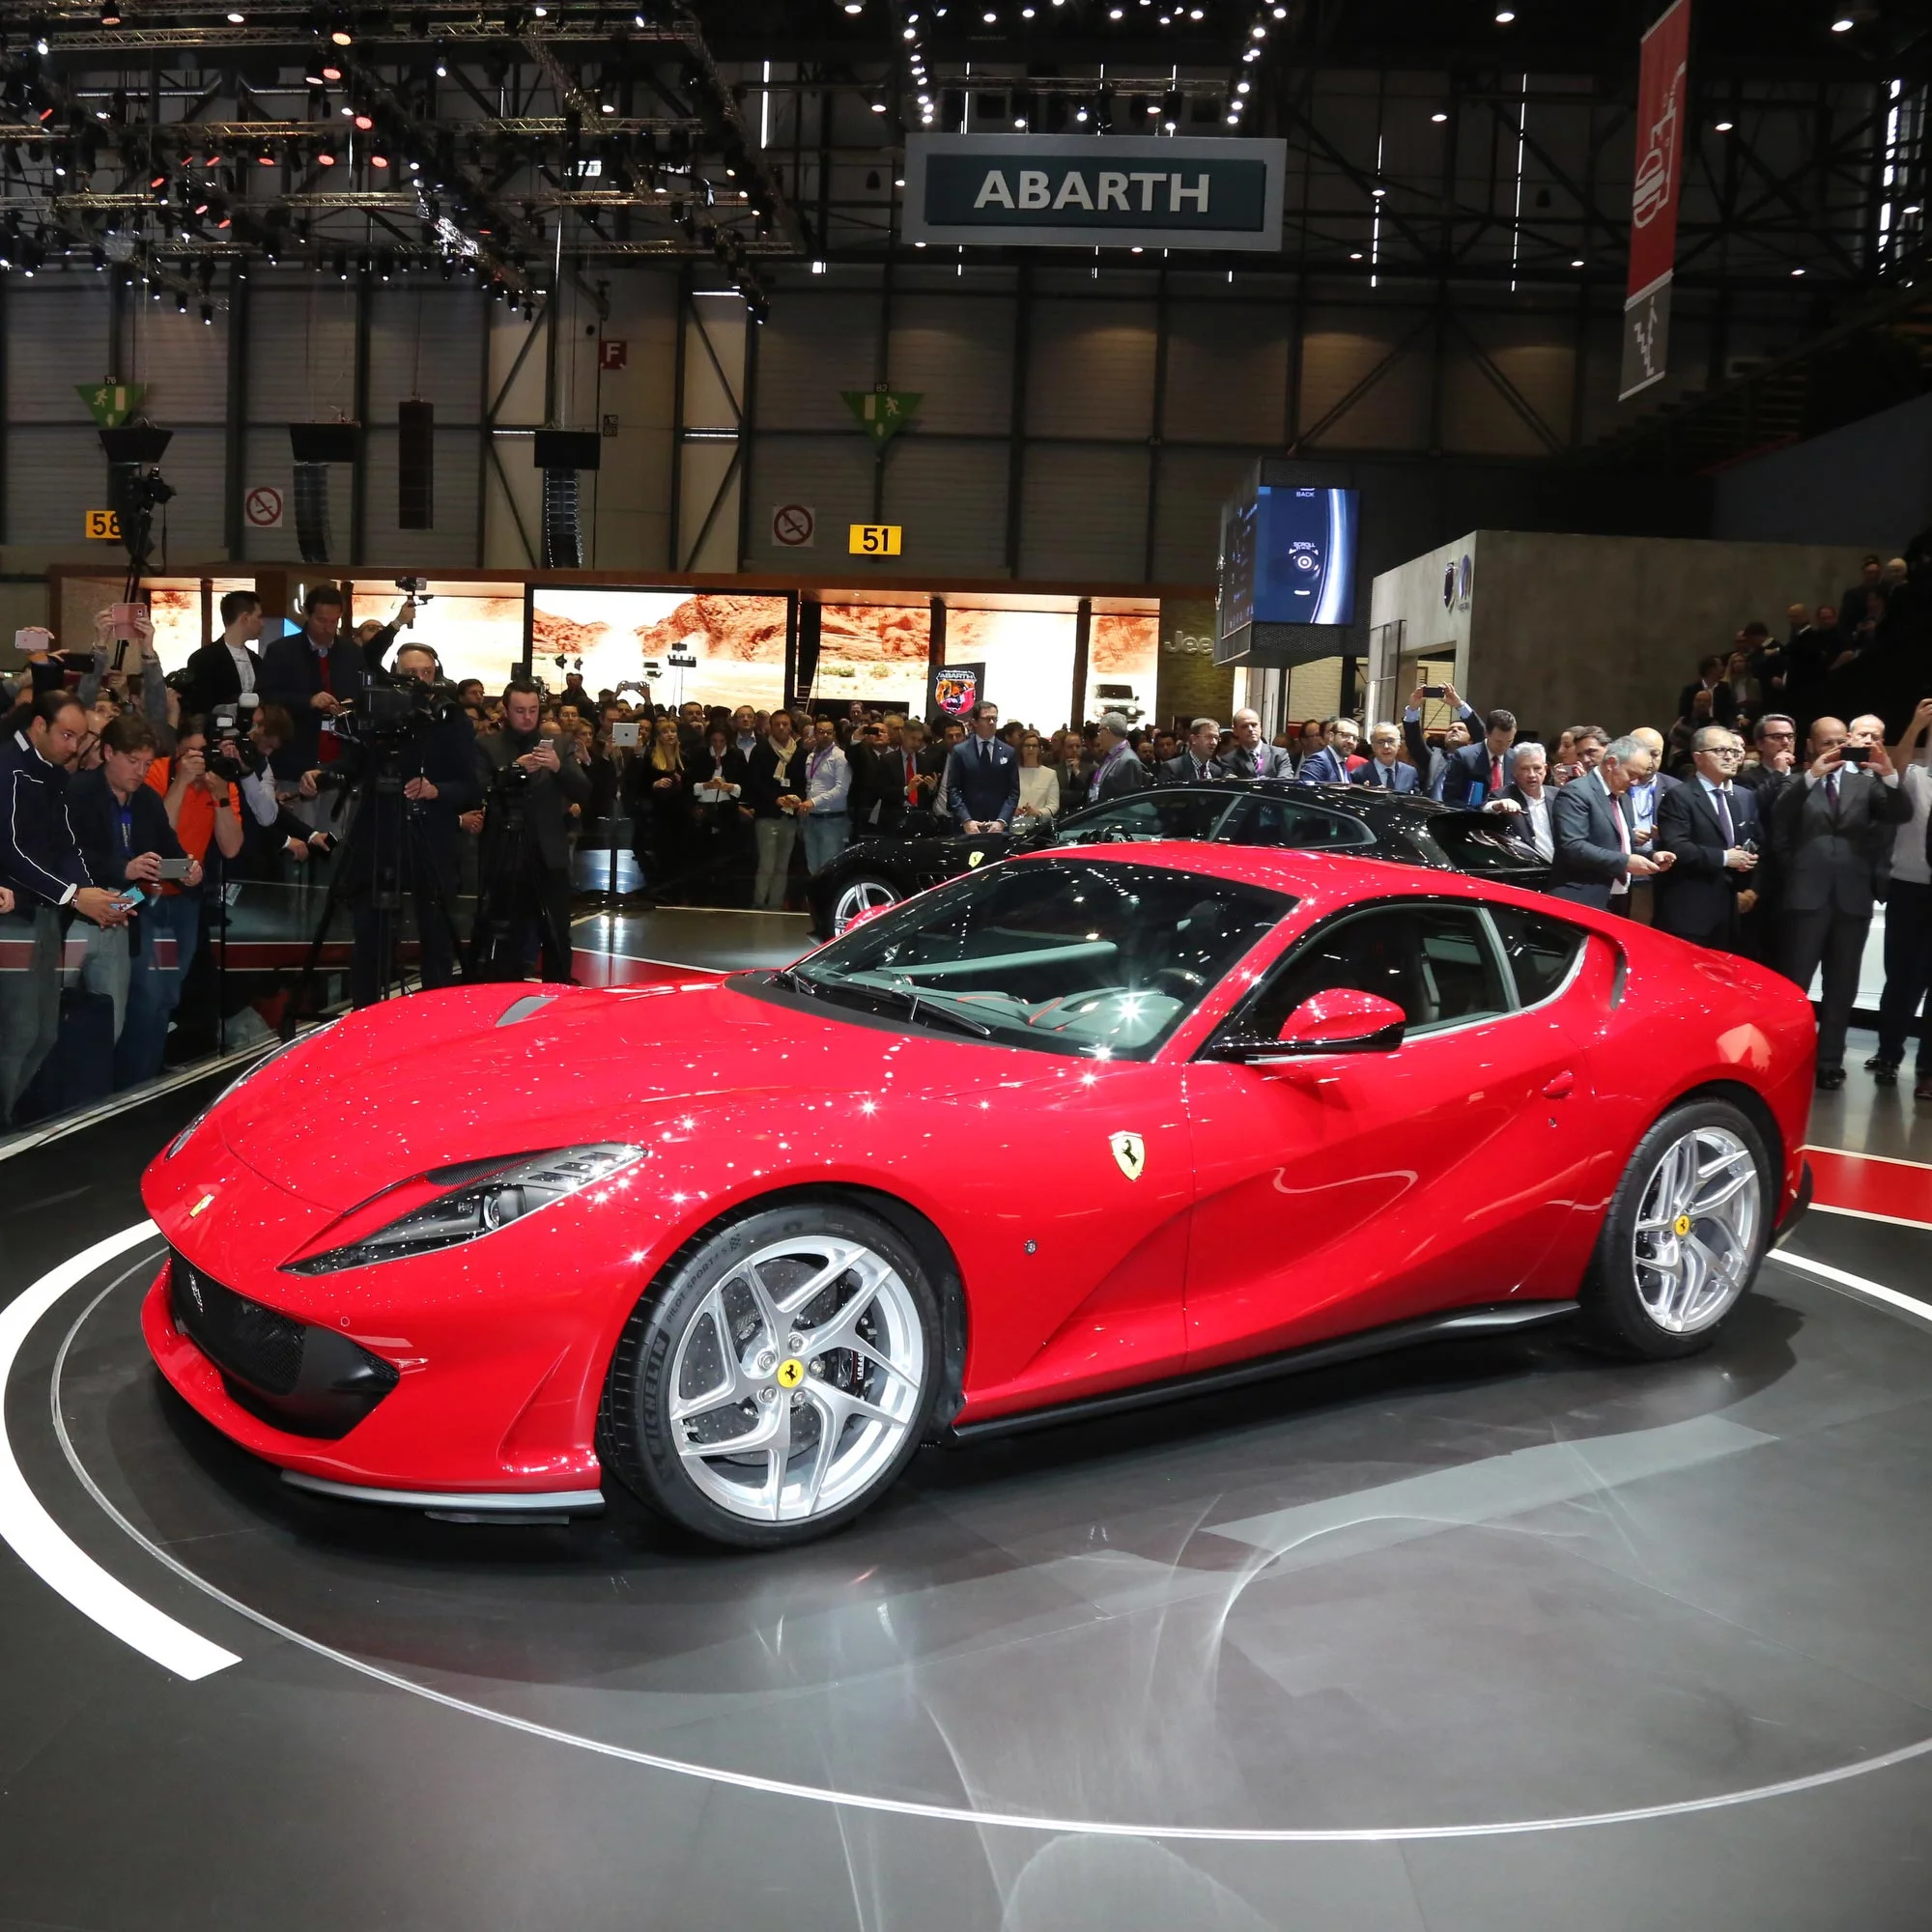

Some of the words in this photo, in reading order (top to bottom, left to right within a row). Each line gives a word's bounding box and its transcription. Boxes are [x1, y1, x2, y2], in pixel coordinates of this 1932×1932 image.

[973, 169, 1209, 213] ABARTH
[607, 343, 620, 362] F
[93, 513, 120, 535] 58
[863, 527, 889, 552] 51
[1164, 631, 1214, 655] Jee
[666, 1292, 686, 1323] PILOT
[687, 1259, 714, 1291] SPORT
[643, 1332, 668, 1456] MICHELIN
